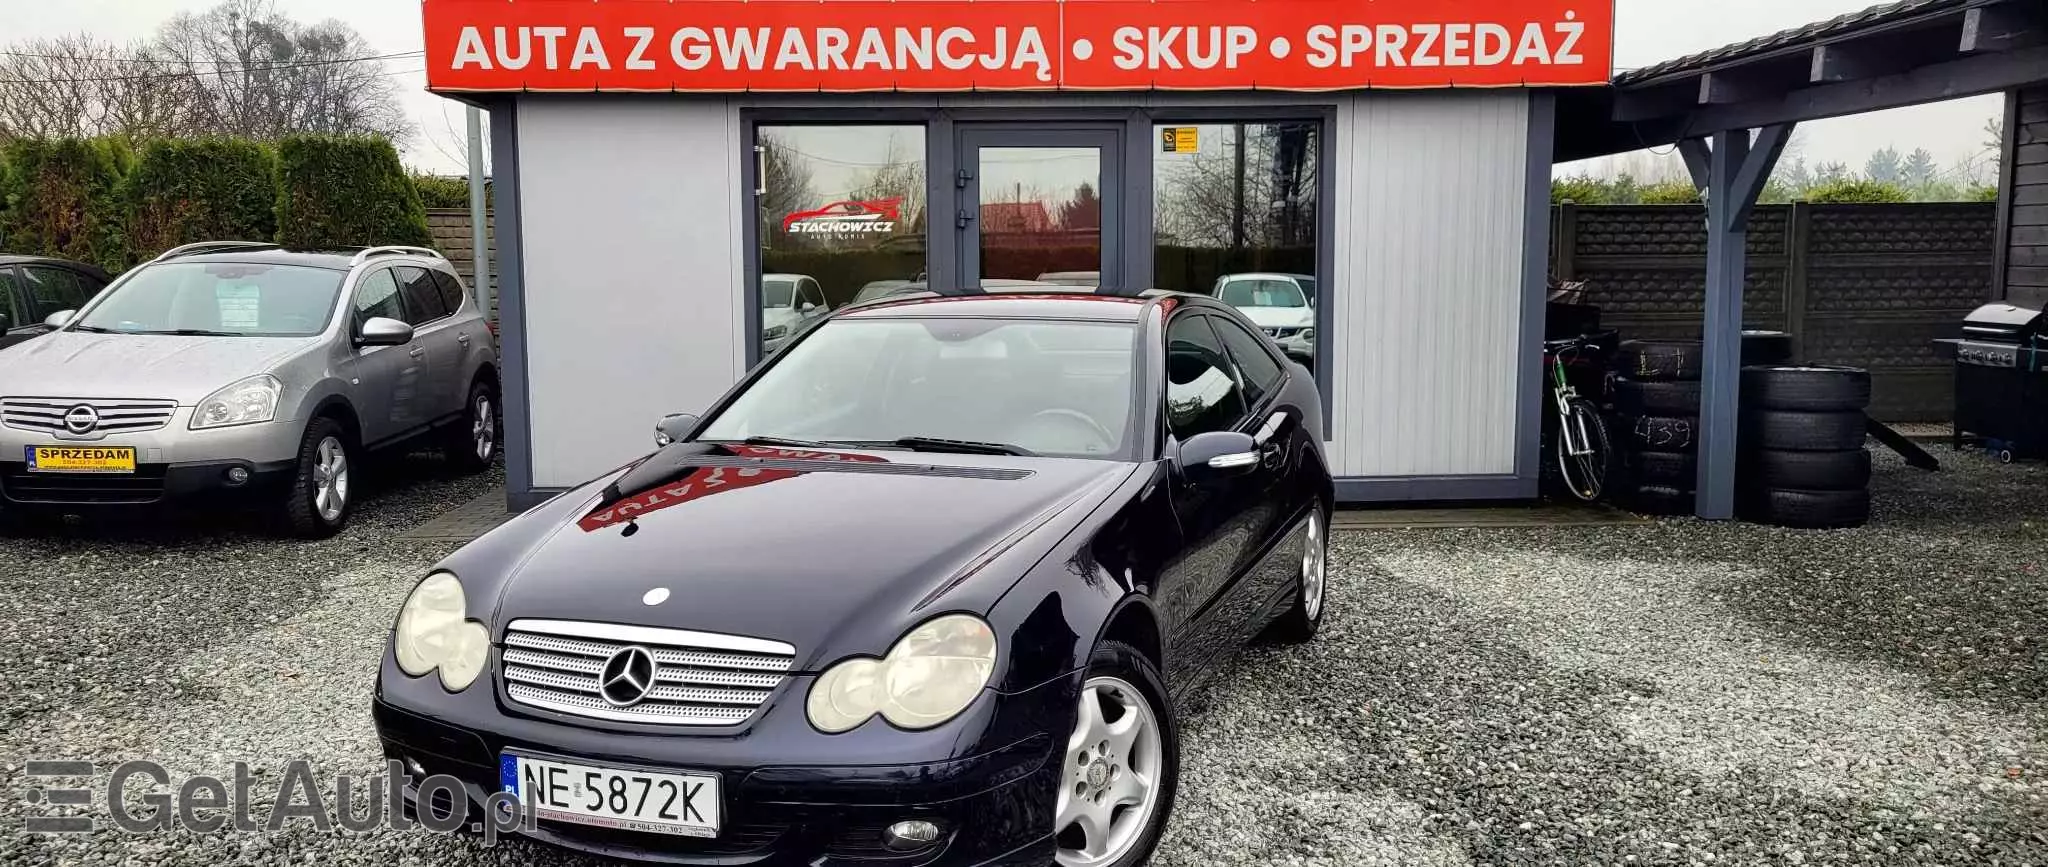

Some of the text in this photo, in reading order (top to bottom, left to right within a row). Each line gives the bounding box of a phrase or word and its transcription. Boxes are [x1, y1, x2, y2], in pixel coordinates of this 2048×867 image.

[451, 10, 1585, 82] AUTA Z GWARANCJĄ SKUP SPRZEDAŻ
[788, 220, 895, 233] STACHOWICZ
[40, 449, 129, 459] SPRZEDAM
[524, 762, 705, 824] NE 5872K
